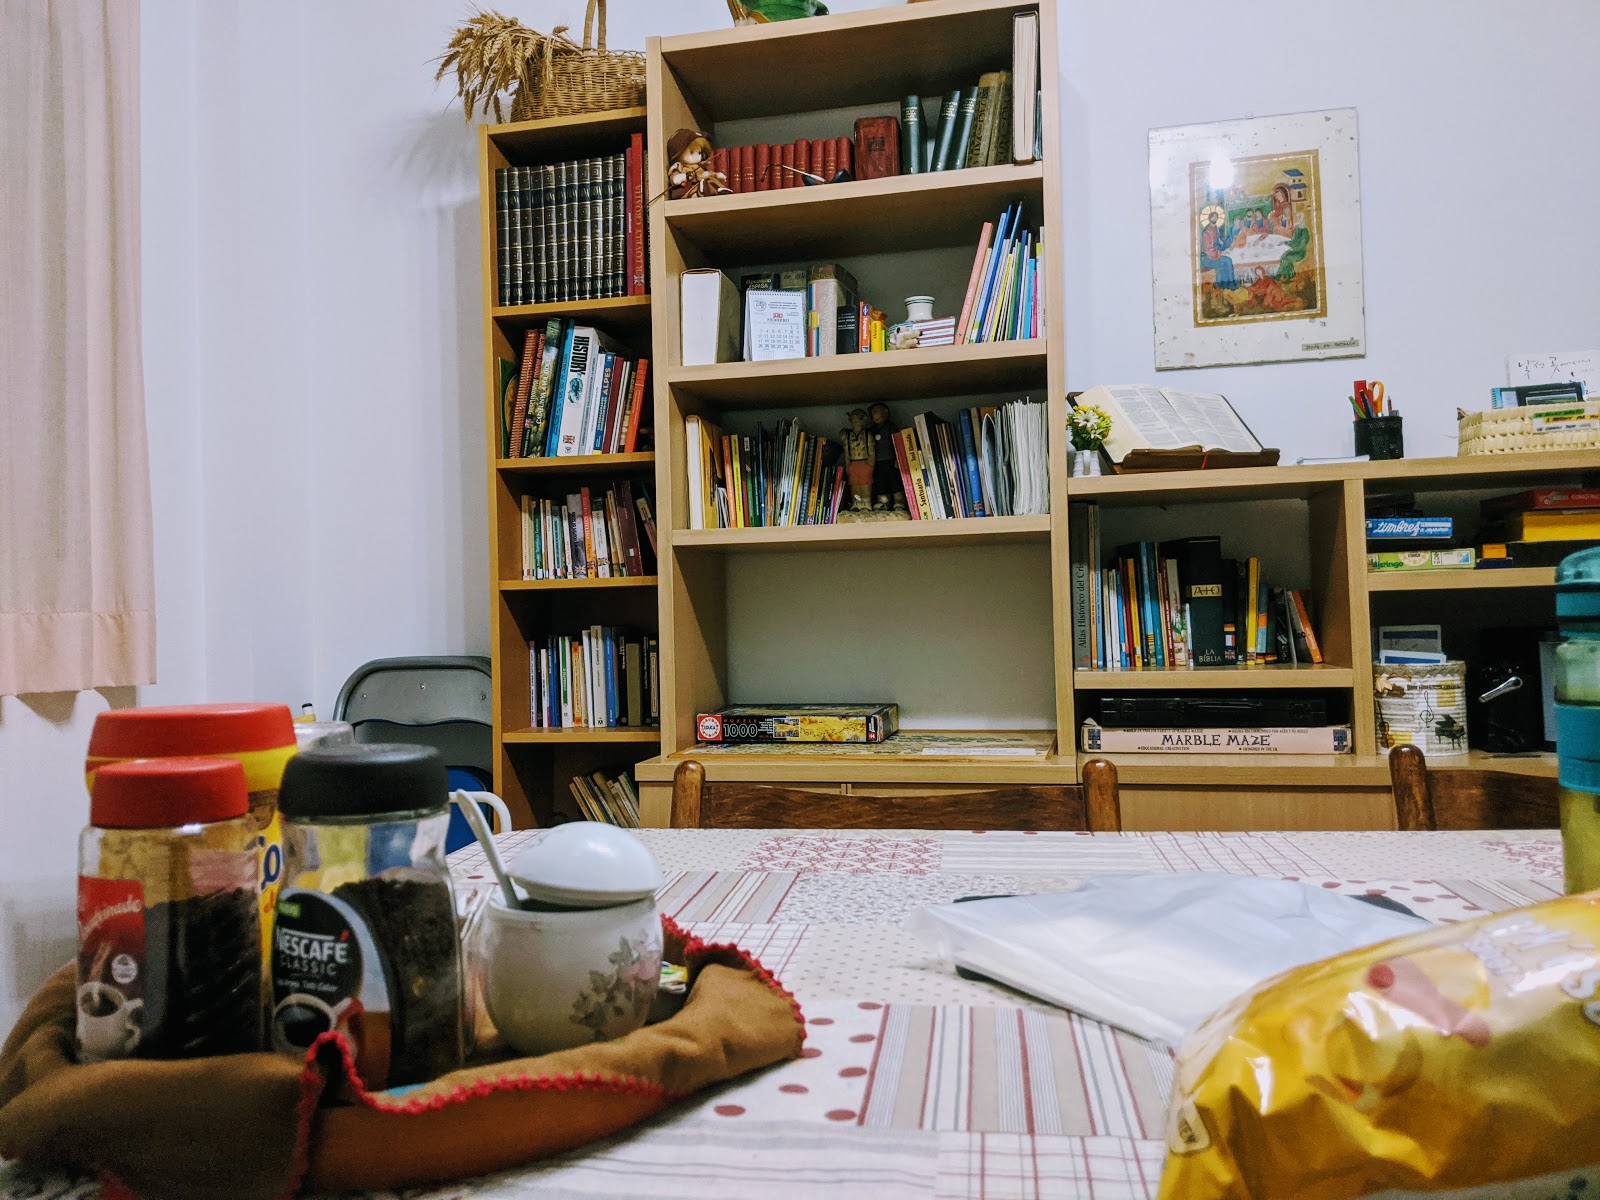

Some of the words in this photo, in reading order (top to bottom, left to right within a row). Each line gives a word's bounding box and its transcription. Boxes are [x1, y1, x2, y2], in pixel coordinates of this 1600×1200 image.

[634, 184, 642, 224] CROATIA
[570, 336, 590, 375] HISTORY
[534, 391, 547, 424] CATALUNYA
[914, 477, 927, 506] Santuario
[1373, 520, 1420, 536] timbres
[1077, 580, 1085, 592] del
[1076, 593, 1086, 627] Histórico
[1078, 628, 1087, 648] Atlas
[723, 724, 757, 737] 1000
[1161, 735, 1221, 746] MARBLE
[1226, 735, 1270, 746] MAZE
[280, 954, 337, 976] CLASSIC
